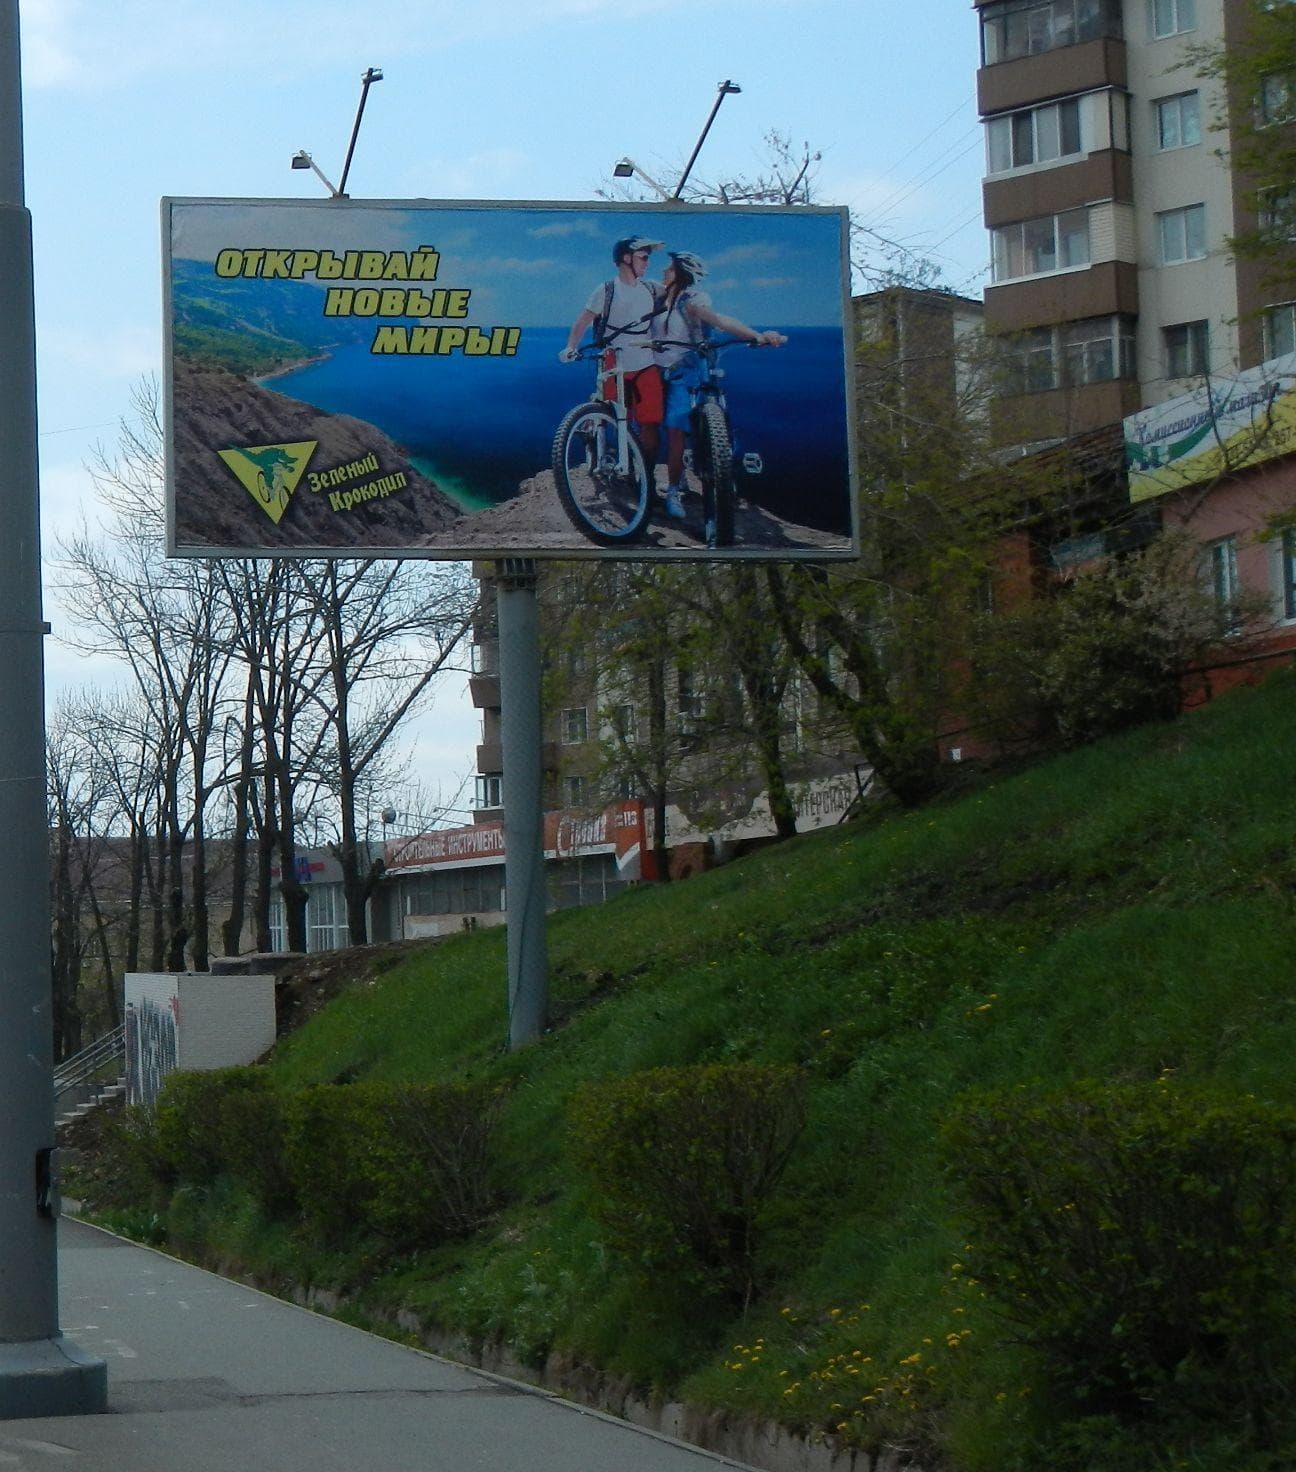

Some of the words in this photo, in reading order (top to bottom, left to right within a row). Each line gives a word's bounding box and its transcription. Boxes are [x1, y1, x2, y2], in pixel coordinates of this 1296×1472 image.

[215, 245, 441, 281] ОТКРЫВАЙ
[323, 287, 471, 318] НОВЫЕ
[370, 325, 522, 355] МИРЫ!
[307, 452, 379, 493] Зеленый
[328, 472, 407, 512] Крокодил
